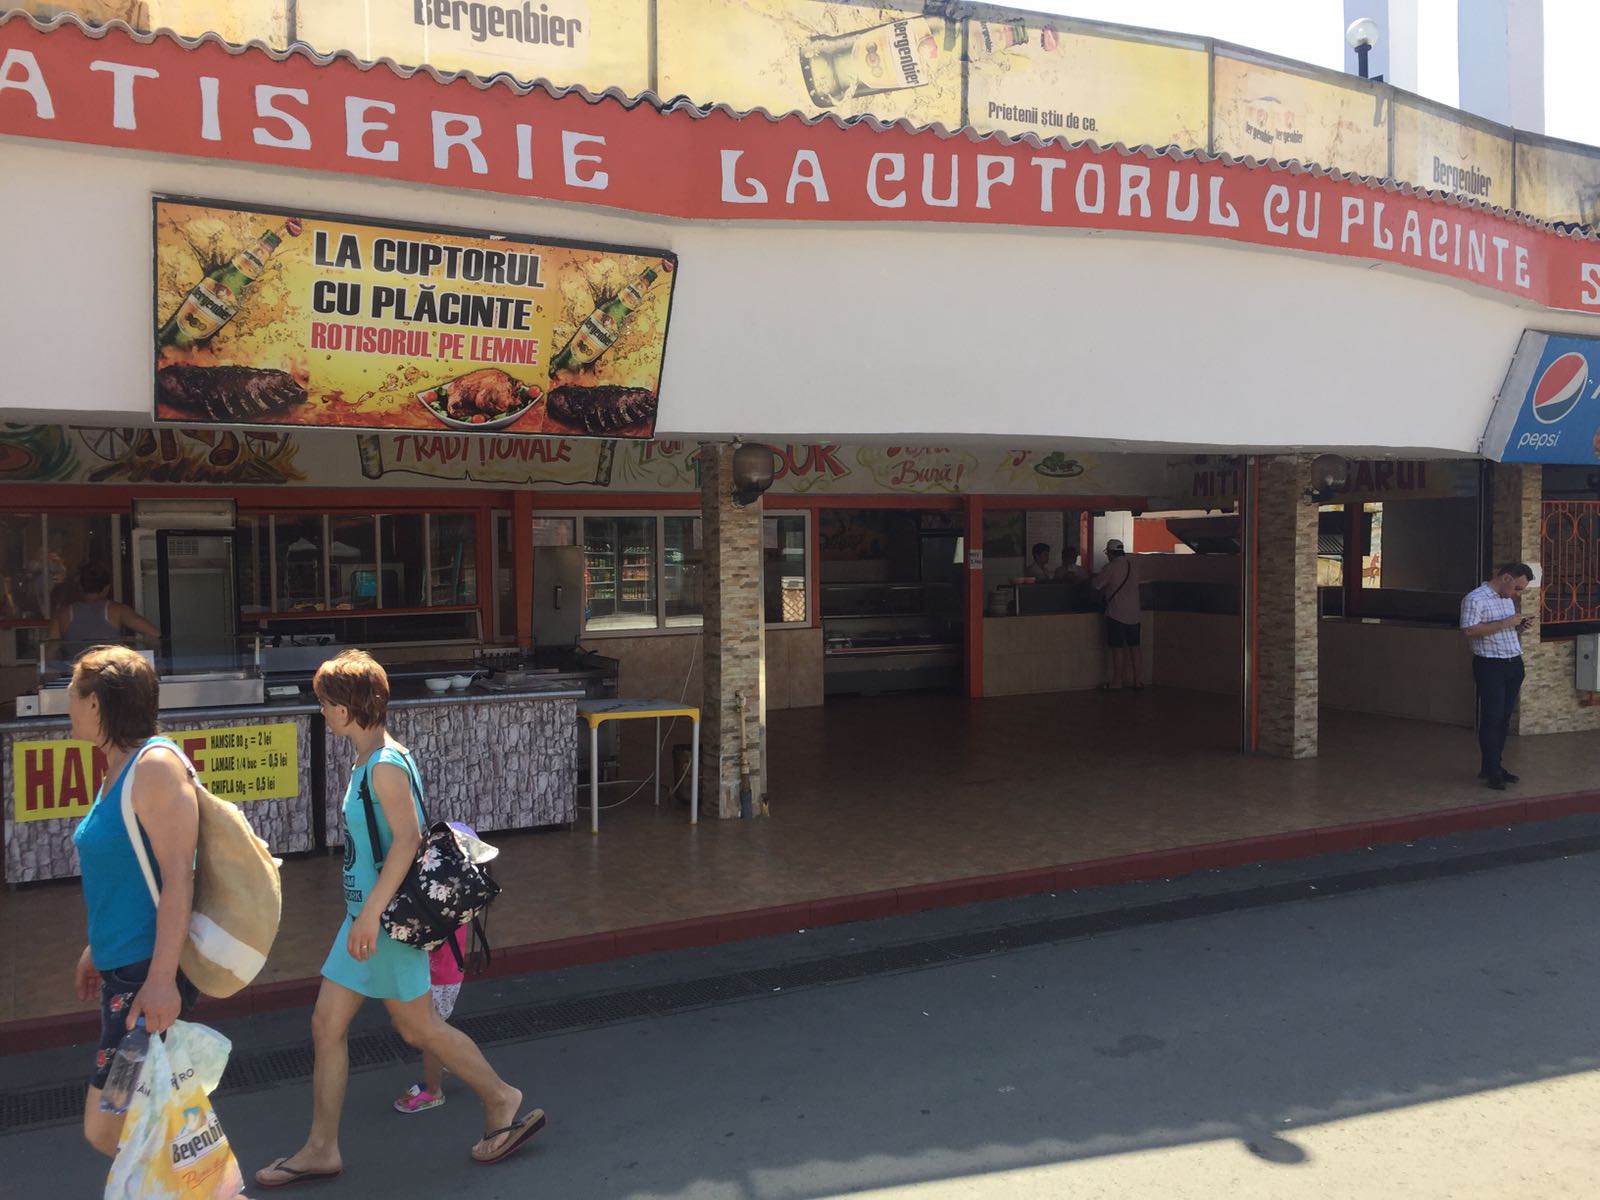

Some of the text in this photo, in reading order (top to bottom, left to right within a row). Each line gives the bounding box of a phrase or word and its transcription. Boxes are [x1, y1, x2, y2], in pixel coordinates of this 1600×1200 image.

[893, 21, 920, 85] Bergenbier
[988, 101, 1038, 124] Prietenii
[1066, 112, 1079, 129] de
[1082, 117, 1099, 132] ce.
[1433, 156, 1492, 197] Bergenbier
[720, 149, 1531, 289] LA CUPTORUL CU PLACINTE
[314, 231, 545, 288] LA CUPTORUL
[313, 280, 533, 331] CU PLĂCINTE
[311, 322, 539, 365] ROTISORUL PE LEMNE
[1517, 430, 1562, 450] pepsi
[210, 734, 235, 749] HAMSIE
[258, 732, 262, 746] 2
[264, 732, 272, 745] lei
[211, 756, 235, 772] LAMAIE
[247, 757, 257, 769] buc
[268, 753, 279, 769] 0,5
[279, 752, 287, 766] lei
[211, 779, 234, 795] CHIFLA
[256, 776, 266, 791] 0,5
[267, 776, 275, 790] lei
